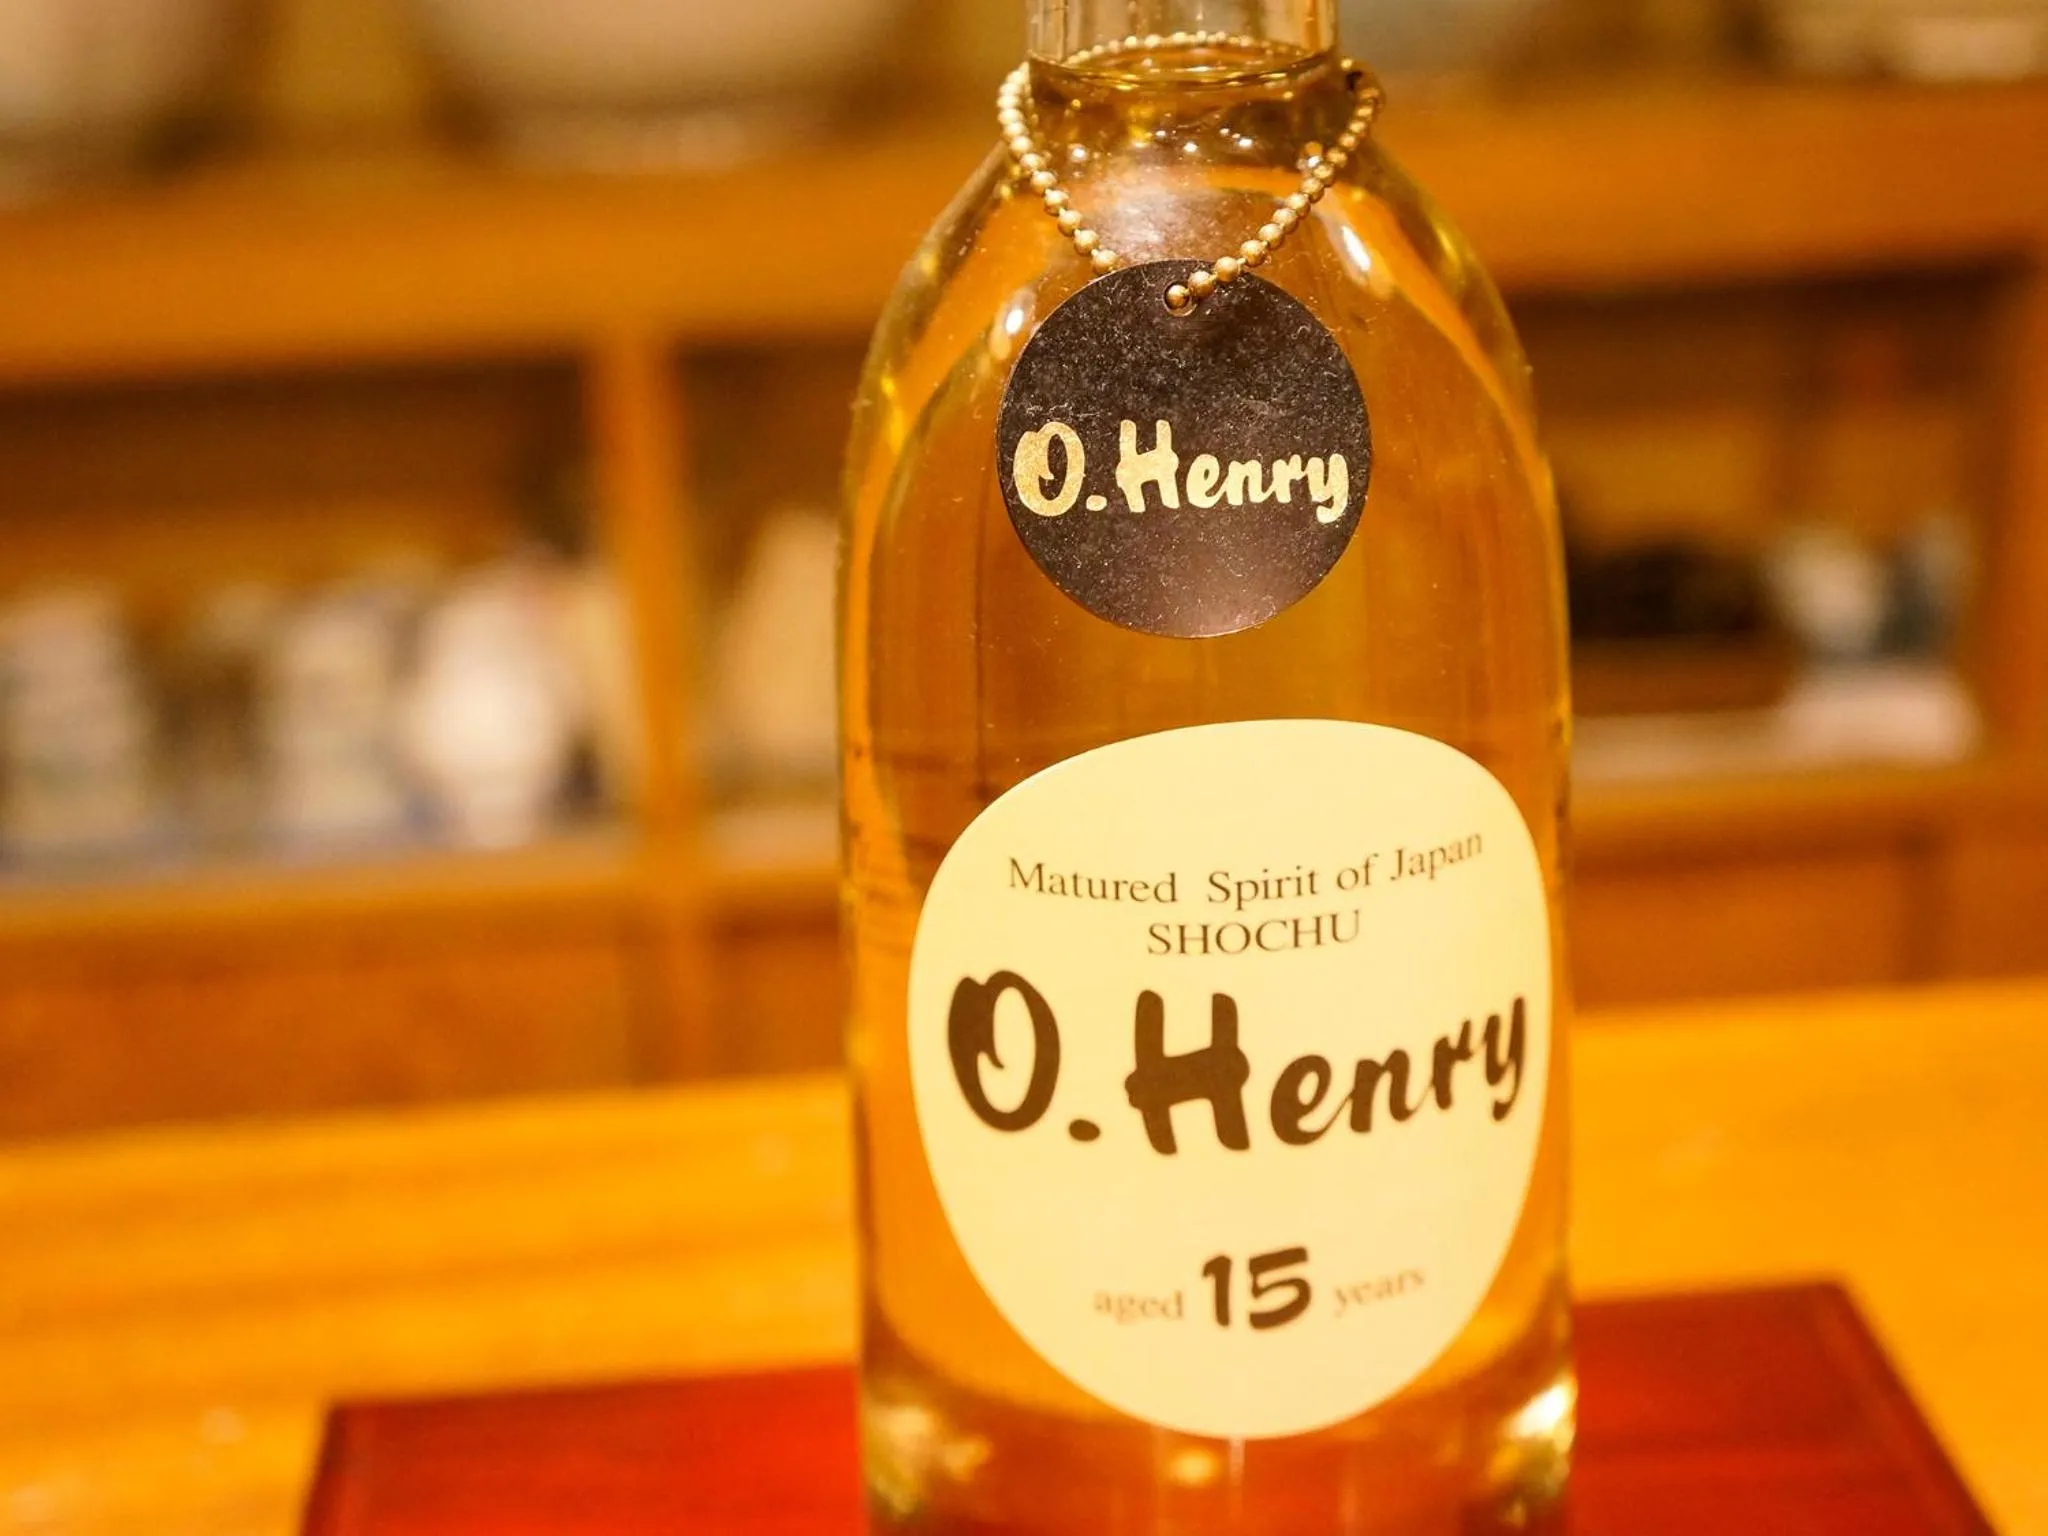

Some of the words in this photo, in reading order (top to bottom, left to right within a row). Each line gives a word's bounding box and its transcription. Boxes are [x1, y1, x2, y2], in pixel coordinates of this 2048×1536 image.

[1008, 856, 1179, 904] Matured
[1206, 864, 1320, 911] Spirit
[1335, 852, 1380, 891] of
[1390, 831, 1484, 882] Japan
[1146, 908, 1362, 957] SHOCHU
[1092, 1289, 1185, 1325] aged
[1201, 1245, 1313, 1330] 15
[1330, 1265, 1426, 1318] years
